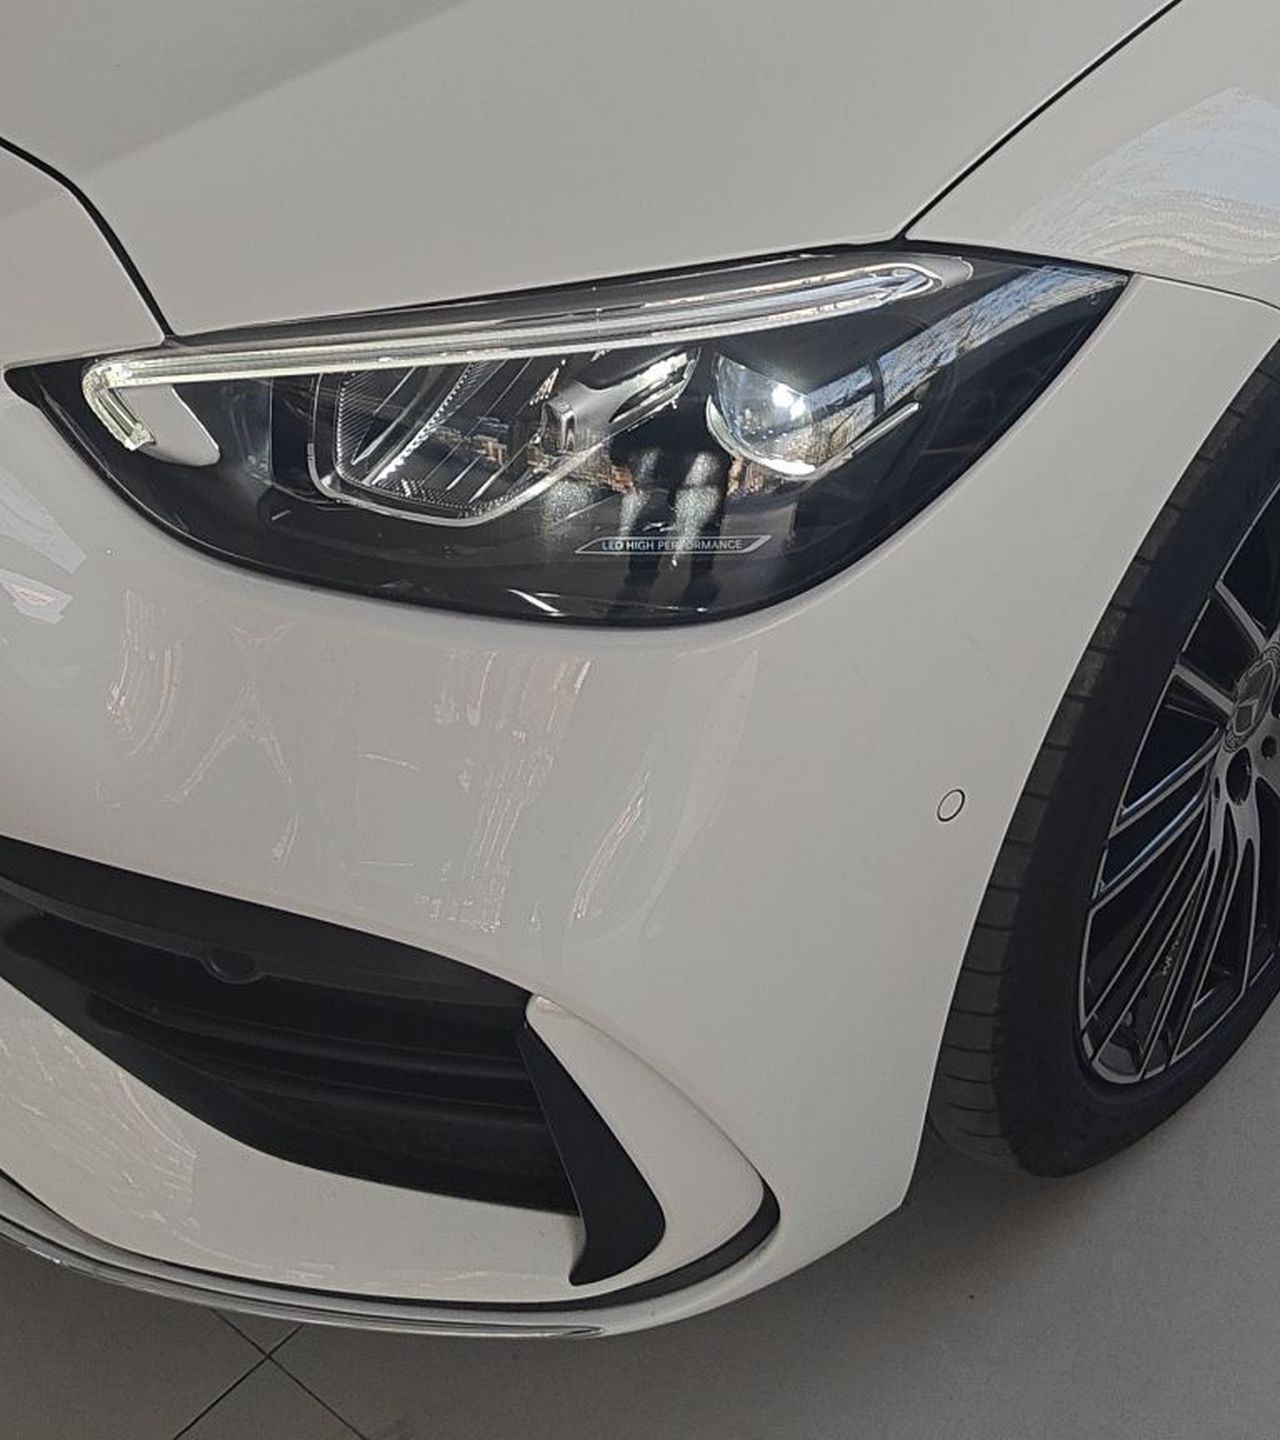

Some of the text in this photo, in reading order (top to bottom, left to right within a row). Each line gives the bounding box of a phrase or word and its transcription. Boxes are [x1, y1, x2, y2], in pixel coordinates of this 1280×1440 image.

[602, 540, 743, 550] LED HIGH PERORMANCE
